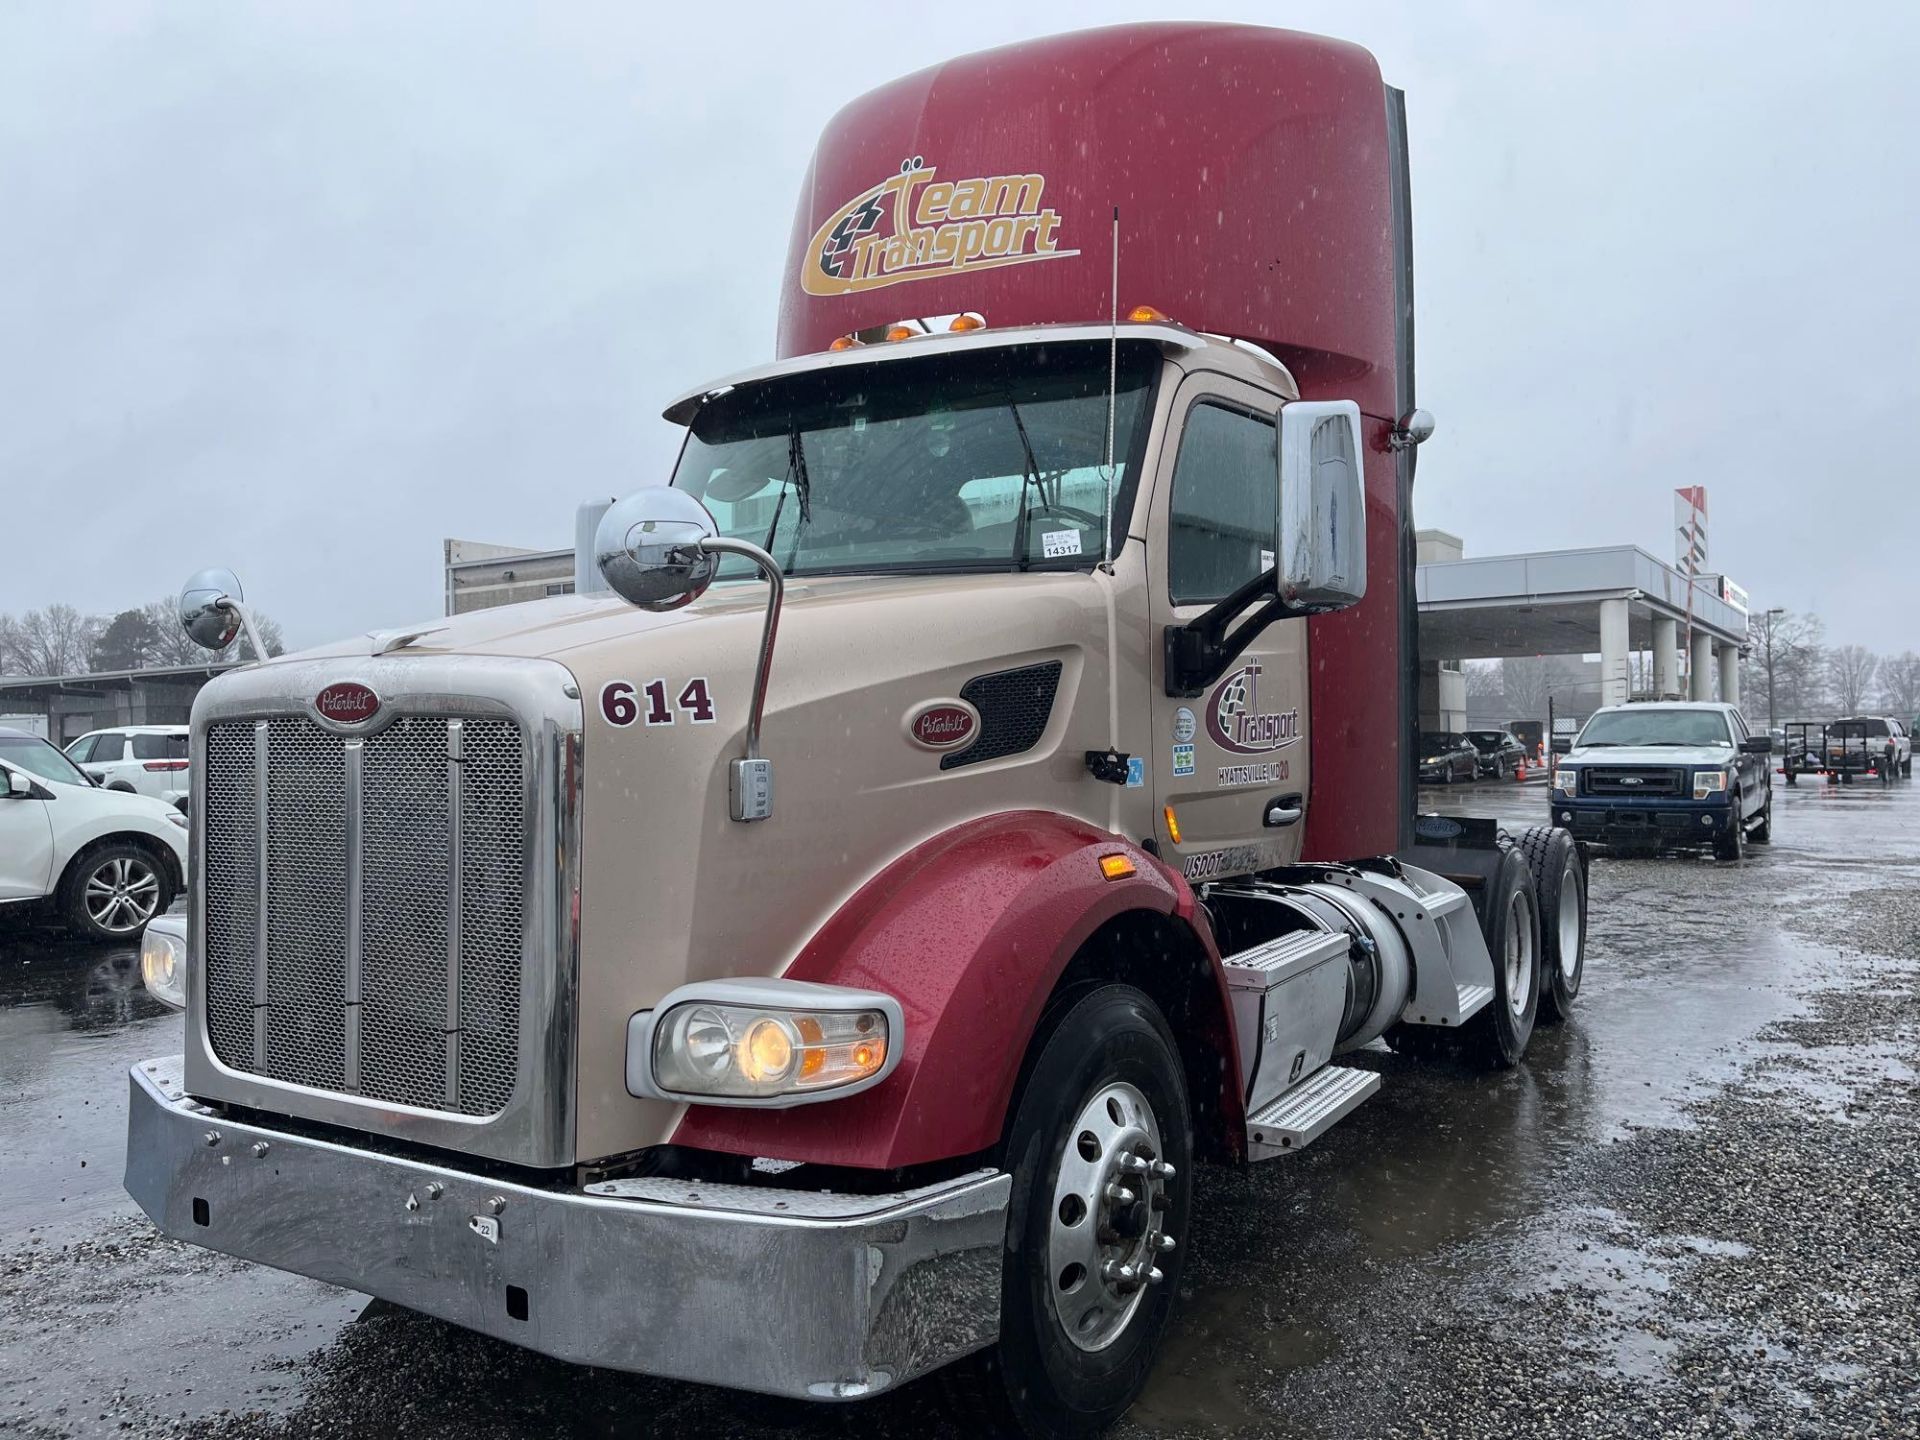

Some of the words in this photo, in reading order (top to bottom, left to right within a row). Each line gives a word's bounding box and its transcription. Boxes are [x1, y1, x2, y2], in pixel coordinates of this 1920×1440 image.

[884, 166, 1045, 228] Team
[851, 209, 1062, 280] Transport
[1046, 544, 1079, 556] 14317
[321, 690, 373, 712] Peterbilt
[600, 677, 716, 728] 614
[921, 714, 968, 736] Peterbilt
[1236, 707, 1298, 749] Transport
[1218, 764, 1268, 786] HYATTSVILLE,
[1183, 851, 1224, 880] USDOT
[481, 1225, 490, 1235] 22
